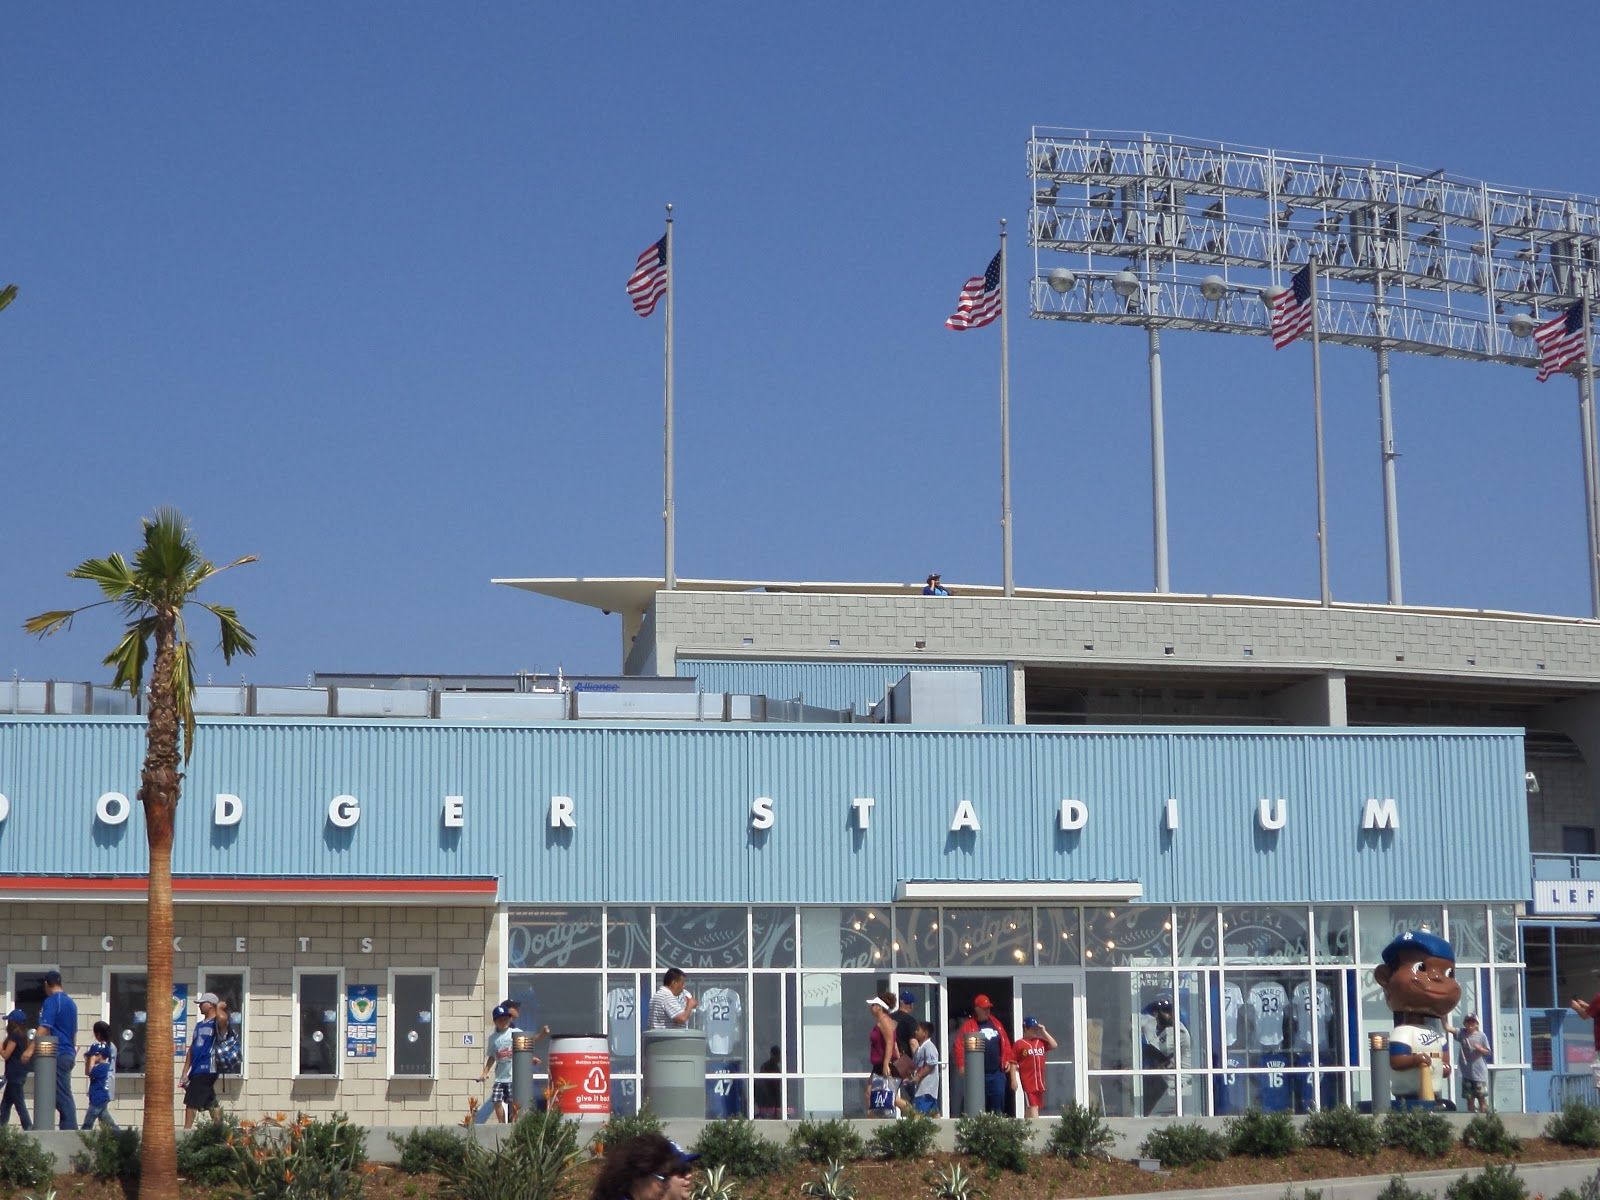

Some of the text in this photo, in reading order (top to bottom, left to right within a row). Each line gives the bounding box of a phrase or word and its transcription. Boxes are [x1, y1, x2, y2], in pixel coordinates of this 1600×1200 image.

[752, 797, 1400, 830] STADIUM
[659, 939, 714, 967] TEAM
[616, 1004, 634, 1020] 27
[712, 1005, 730, 1020] 22
[1262, 997, 1279, 1013] 23
[714, 1079, 733, 1096] 47
[1269, 1072, 1284, 1088] 16
[620, 1080, 635, 1097] 13
